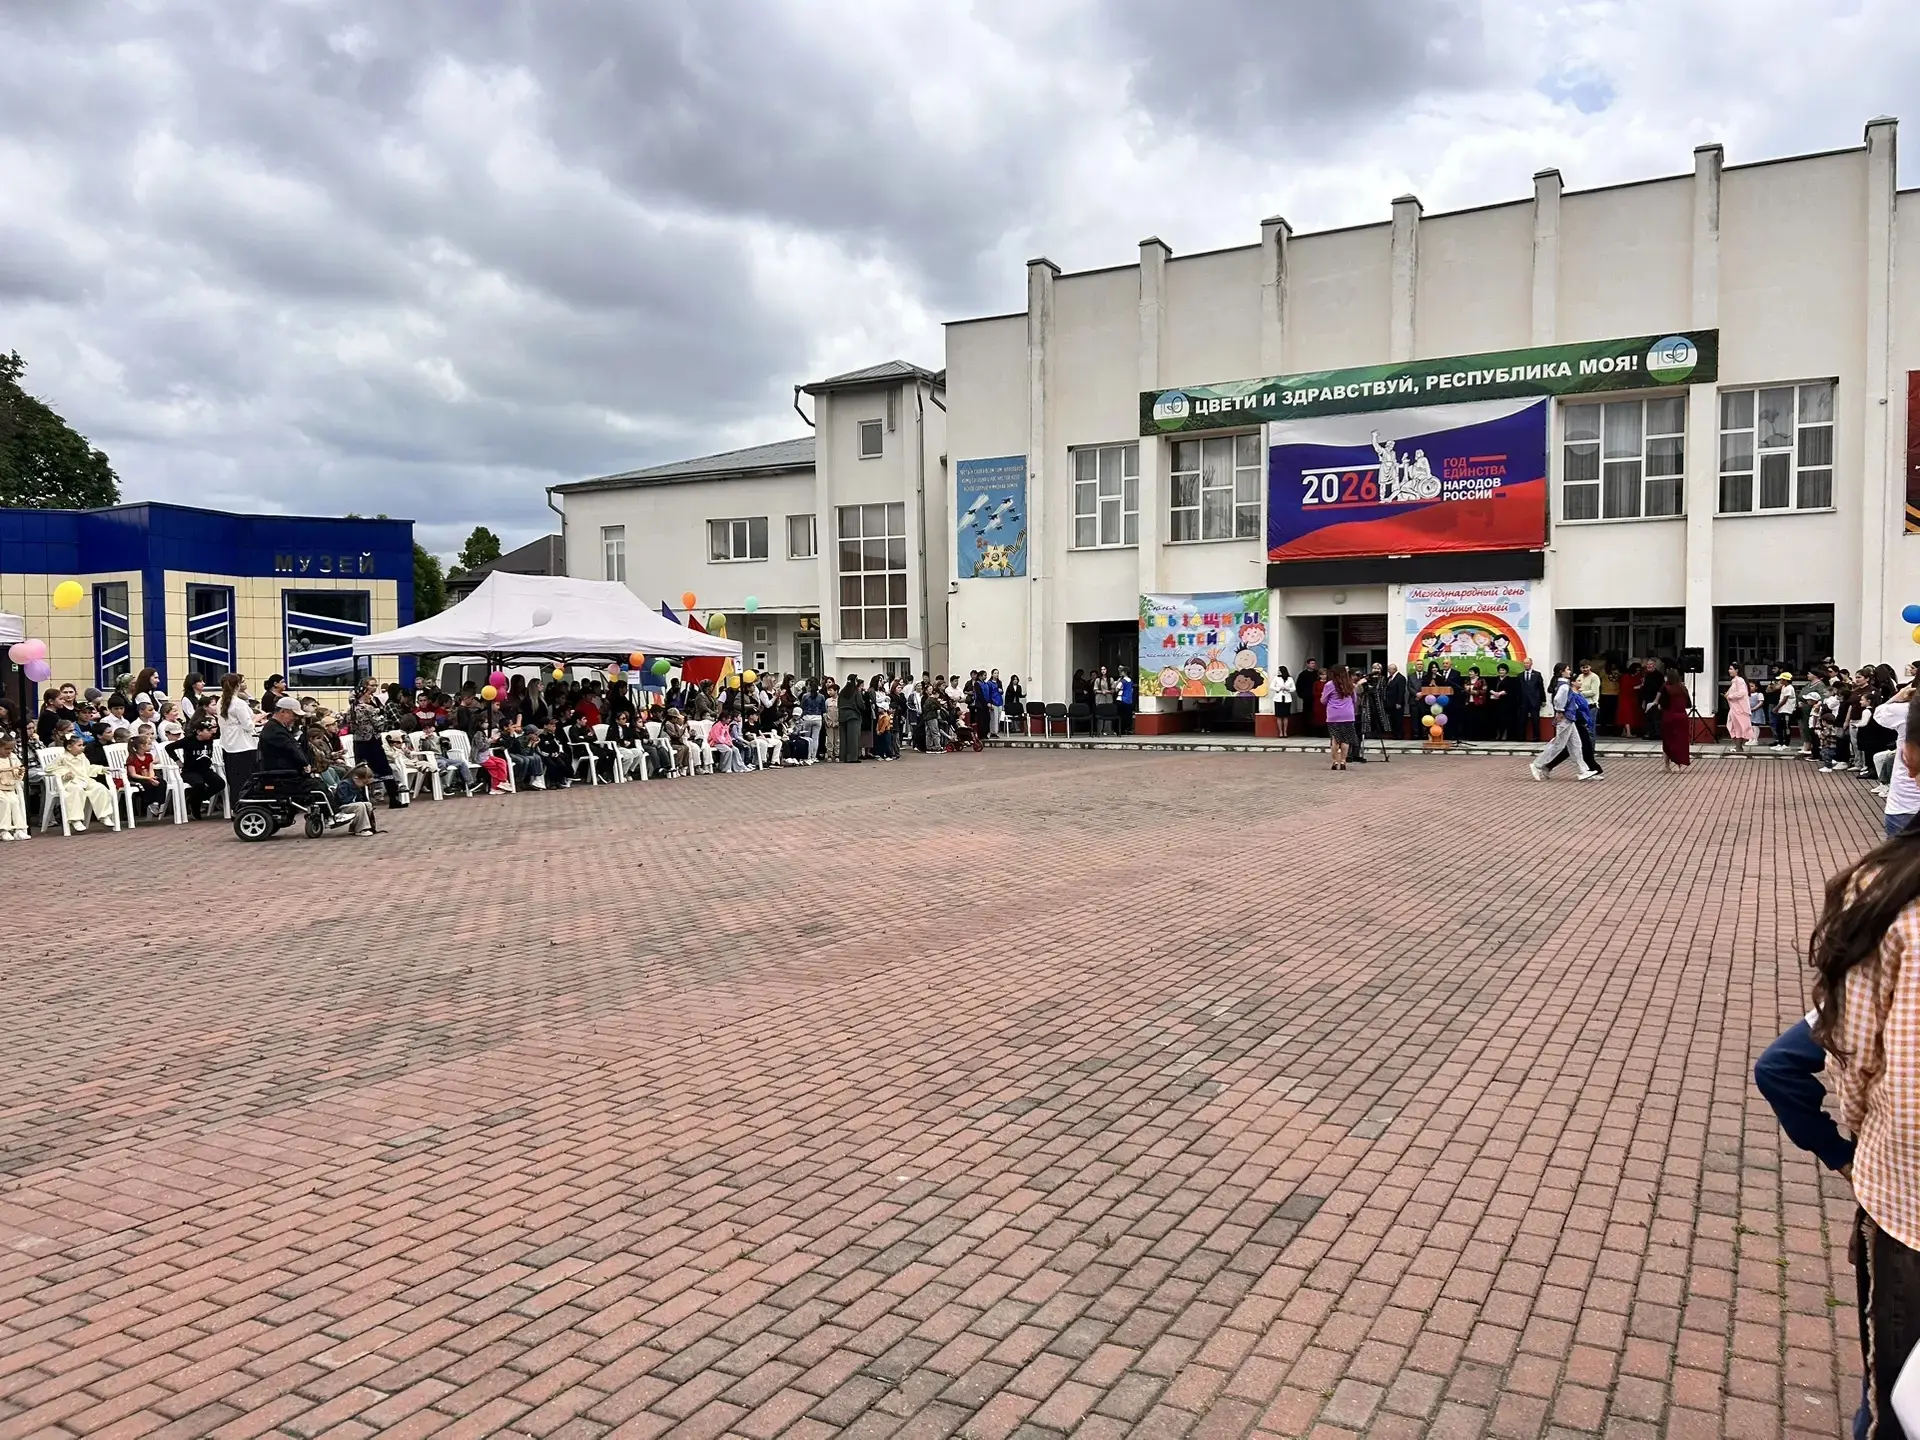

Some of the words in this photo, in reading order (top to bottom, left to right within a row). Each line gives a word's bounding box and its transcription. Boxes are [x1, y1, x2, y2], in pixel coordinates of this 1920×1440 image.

[1195, 395, 1256, 415] ЦВЕТИ
[1263, 392, 1276, 407] И
[1282, 375, 1419, 406] ЗДРАВСТВУЙ,
[1426, 361, 1572, 391] РЕСПУБЛИКА
[1579, 355, 1638, 374] МОЯ!
[1443, 457, 1467, 468] ГОД
[1443, 465, 1506, 479] ЕДИНСТВА
[1302, 471, 1377, 504] 2026
[1443, 478, 1502, 490] НАРОДОВ
[1443, 489, 1493, 501] РОССИИ
[275, 552, 374, 574] МУЗЕЙ
[1412, 586, 1498, 601] Международный
[1502, 586, 1525, 596] день
[1425, 604, 1473, 617] защиты
[1477, 602, 1510, 612] детей
[1182, 612, 1259, 628] ЗАЩИТЫ
[1162, 629, 1226, 648] ДЕТЕЙ!
